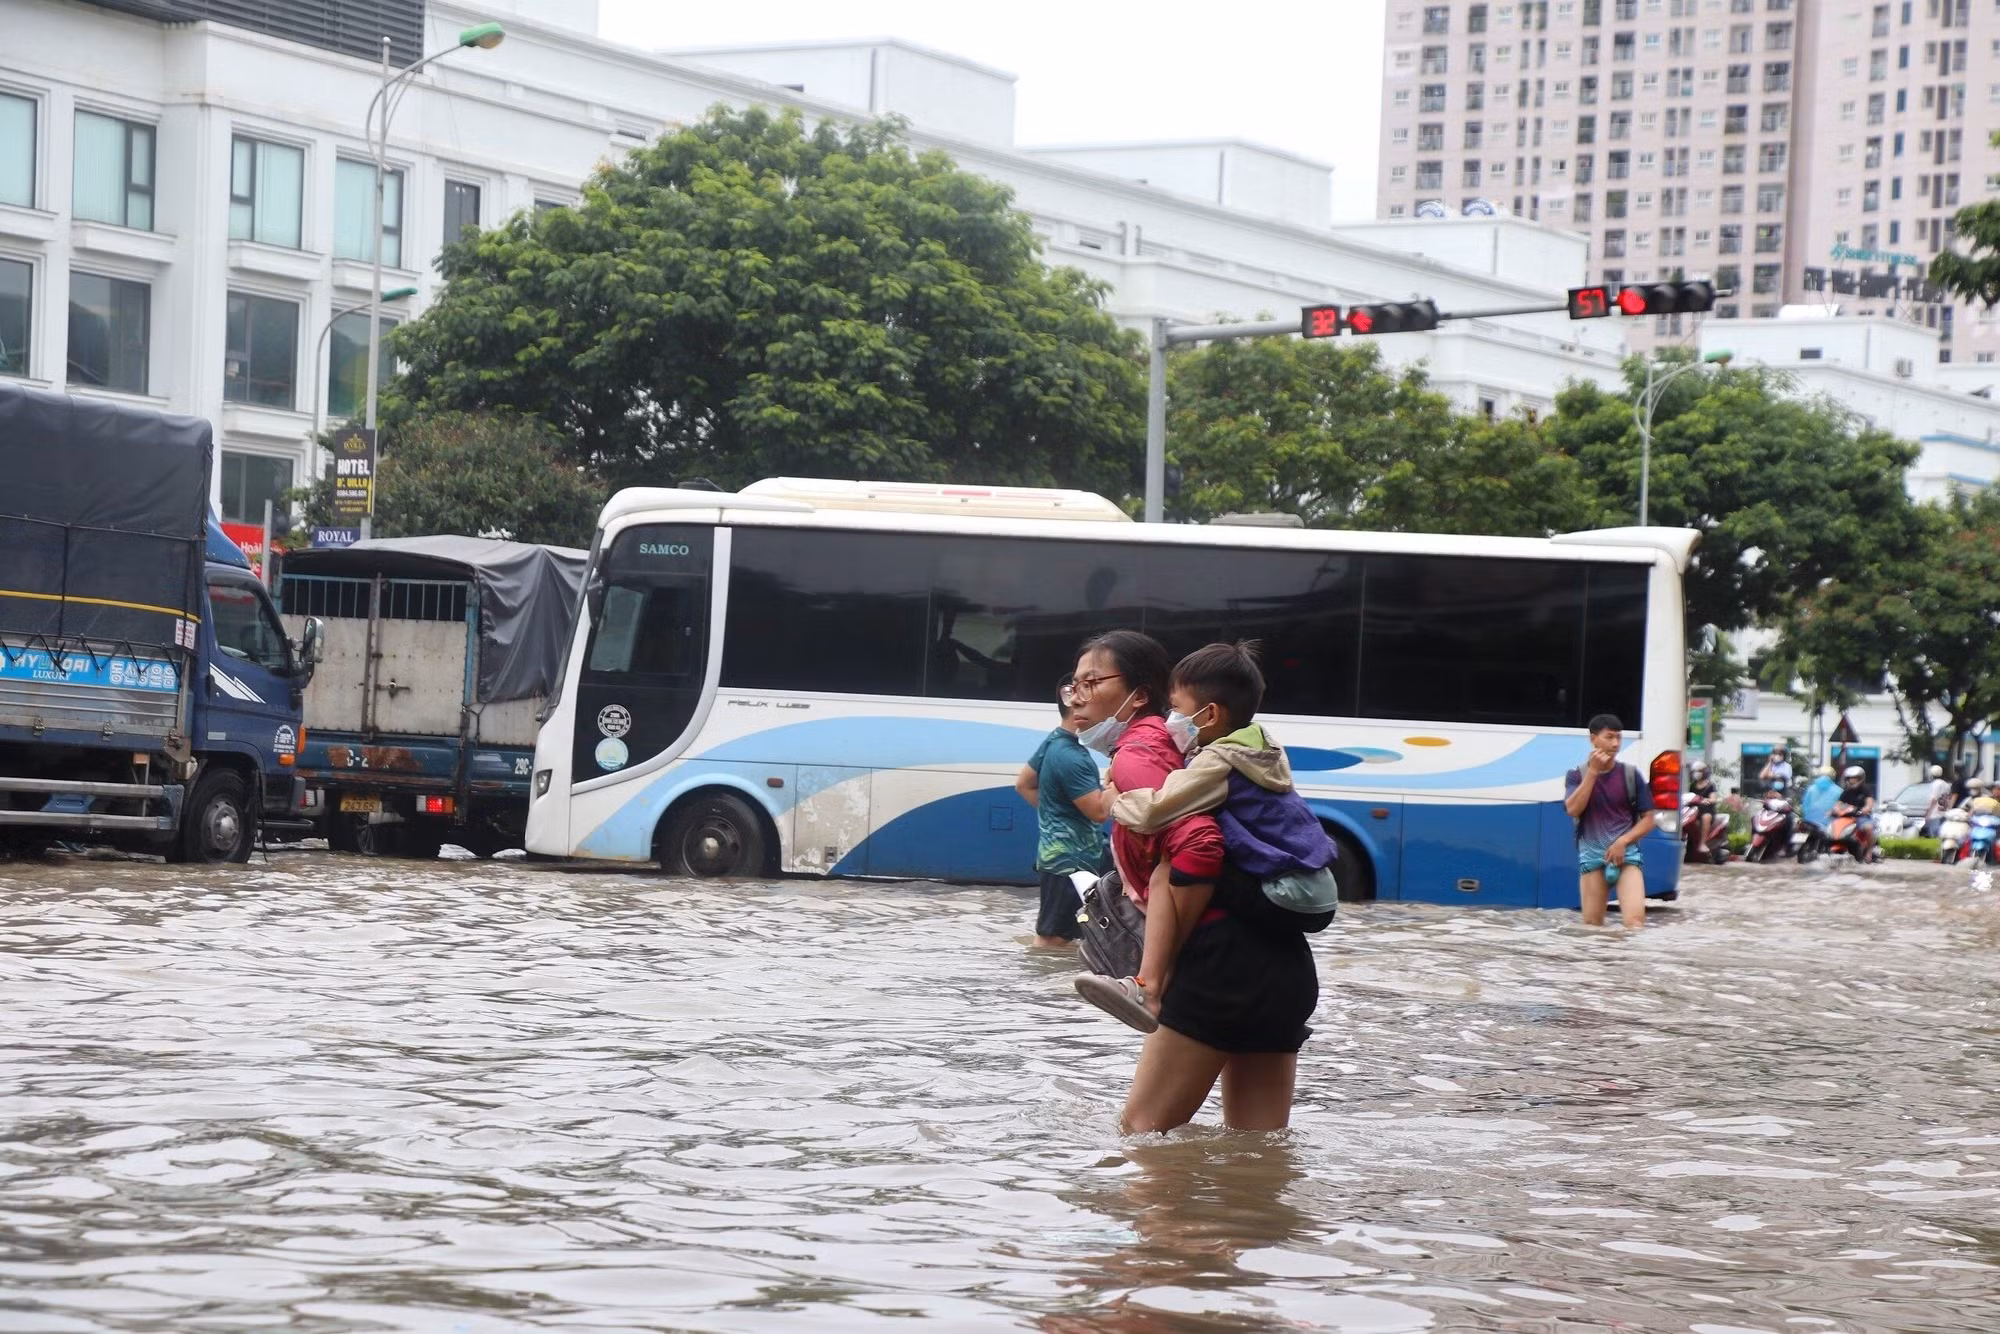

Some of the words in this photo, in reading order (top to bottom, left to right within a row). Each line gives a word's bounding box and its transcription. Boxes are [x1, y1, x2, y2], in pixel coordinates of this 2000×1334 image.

[1312, 309, 1336, 336] 32
[337, 459, 370, 475] HOTEL
[318, 530, 354, 542] ROYAL
[639, 543, 690, 556] SAMCO
[32, 669, 72, 681] LUXURY
